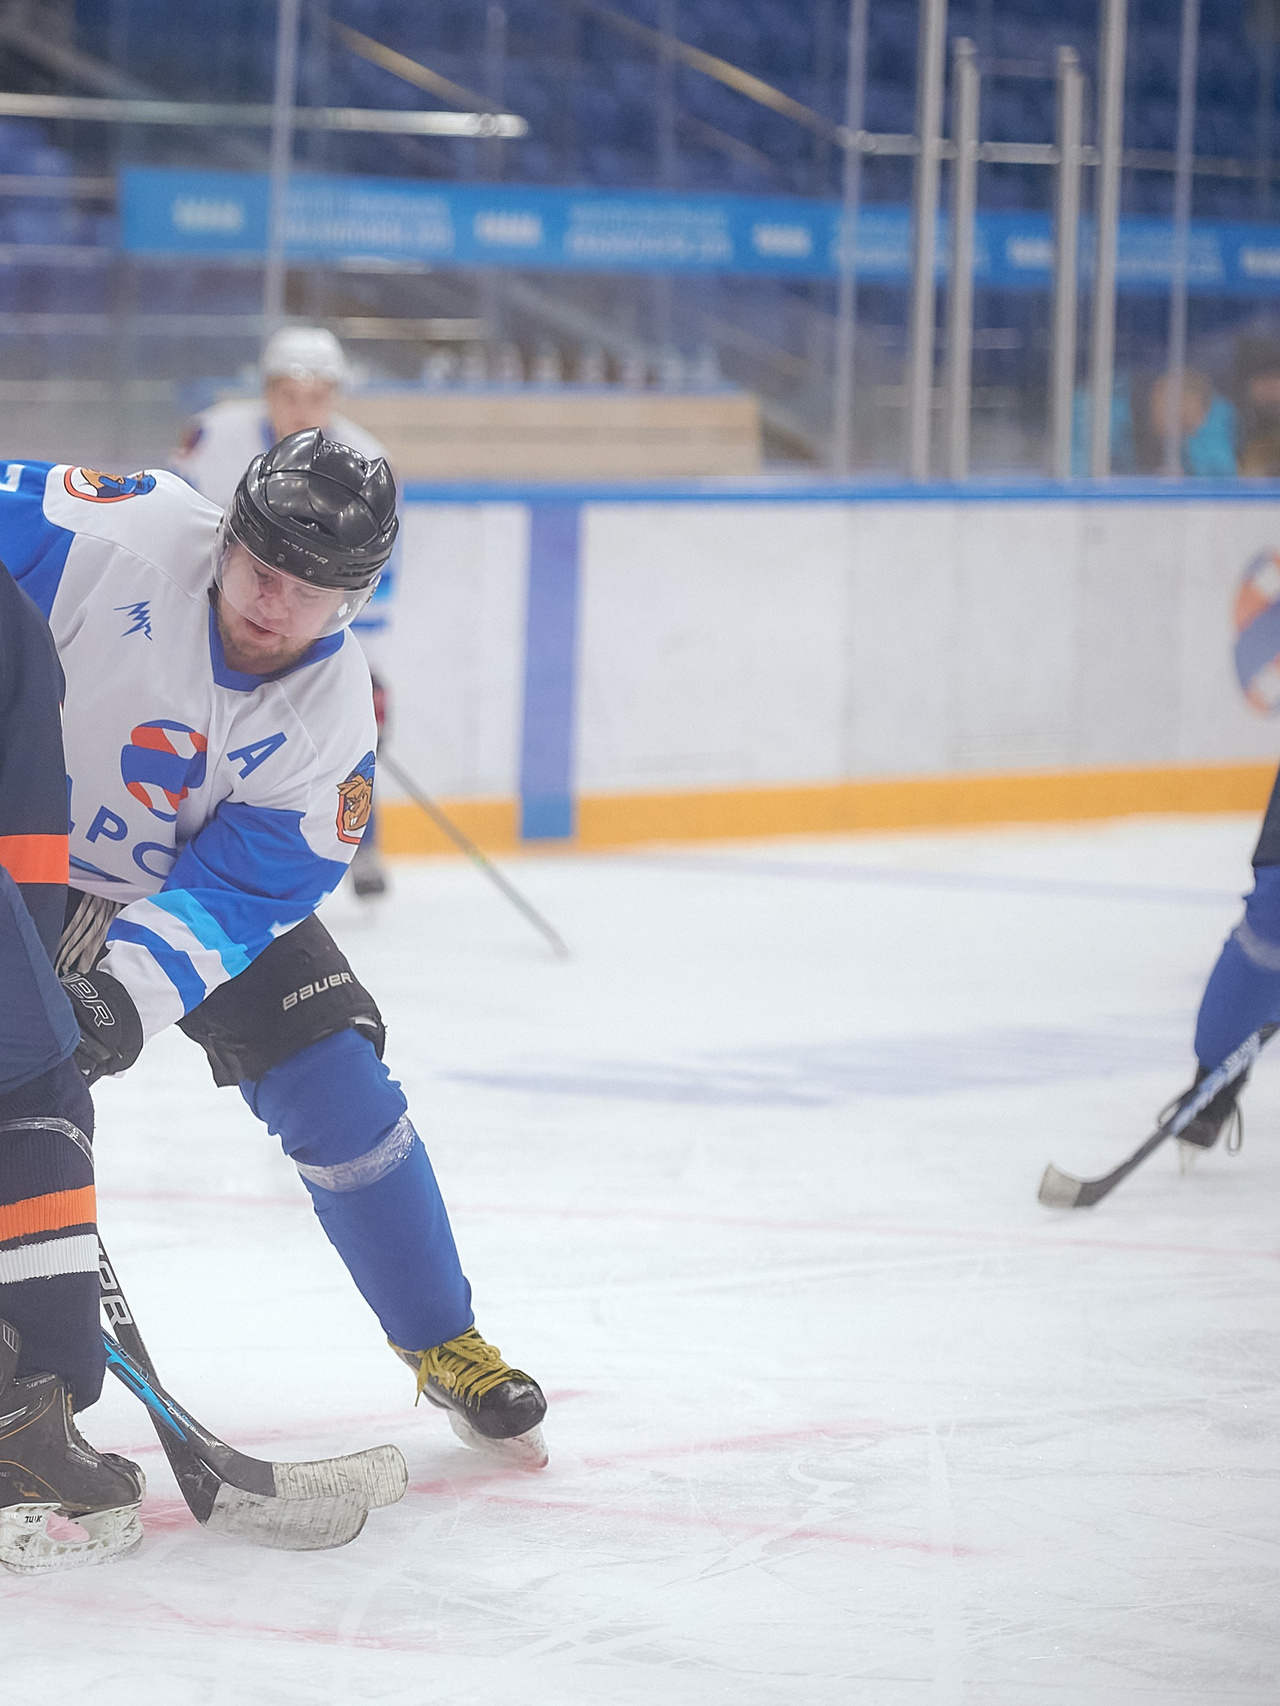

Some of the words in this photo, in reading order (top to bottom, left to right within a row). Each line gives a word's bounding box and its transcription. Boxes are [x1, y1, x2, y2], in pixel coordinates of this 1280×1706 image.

[227, 731, 288, 780] A
[282, 971, 354, 1012] BAUER
[98, 1250, 133, 1327] OR
